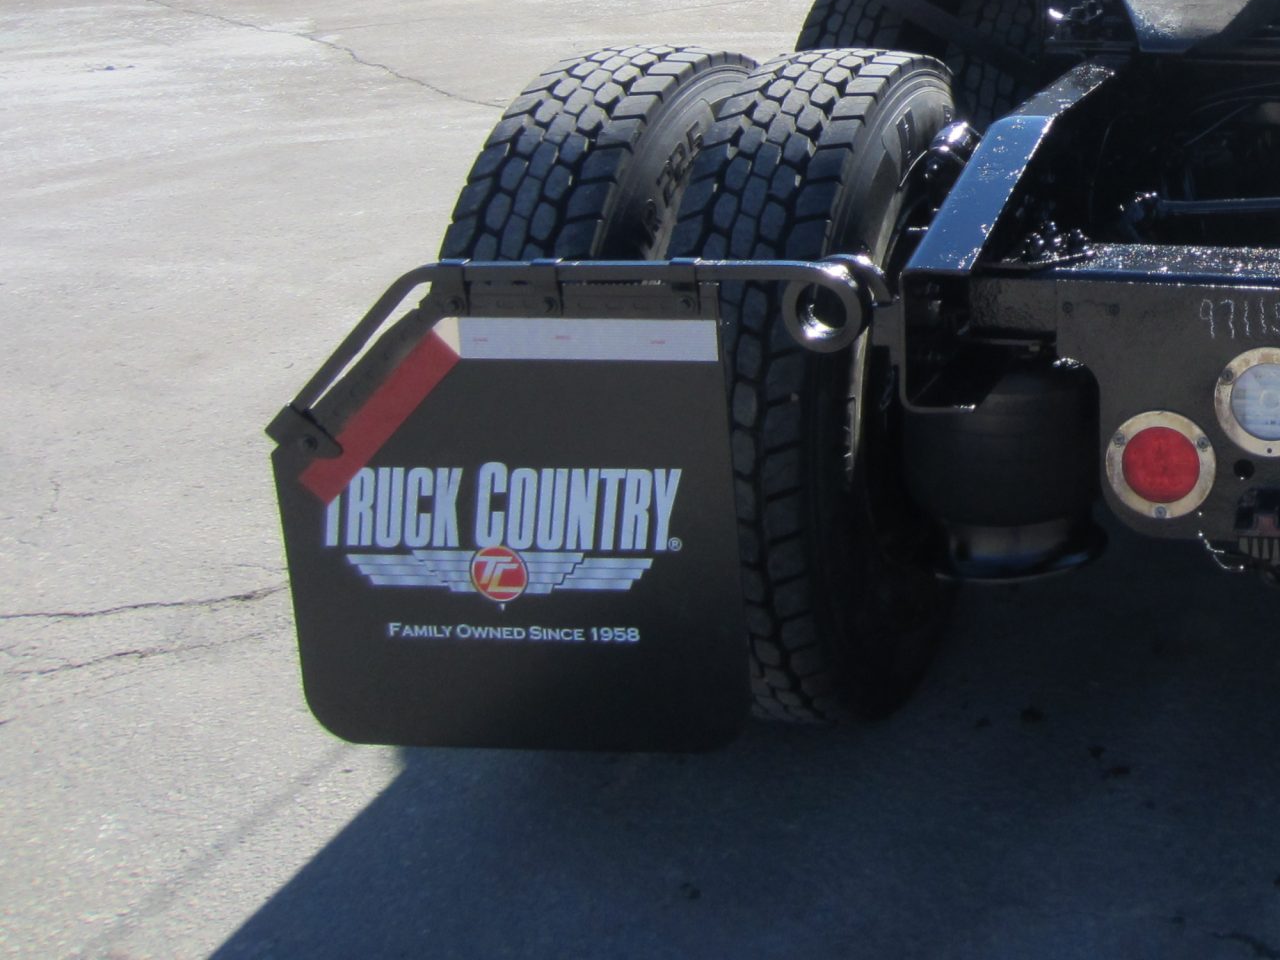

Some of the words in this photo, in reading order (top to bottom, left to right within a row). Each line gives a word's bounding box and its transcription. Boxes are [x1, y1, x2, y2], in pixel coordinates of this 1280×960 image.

[389, 622, 453, 638] FAMILY
[456, 624, 526, 640] OWNED
[529, 626, 586, 642] SINCE
[591, 627, 641, 642] 1958
